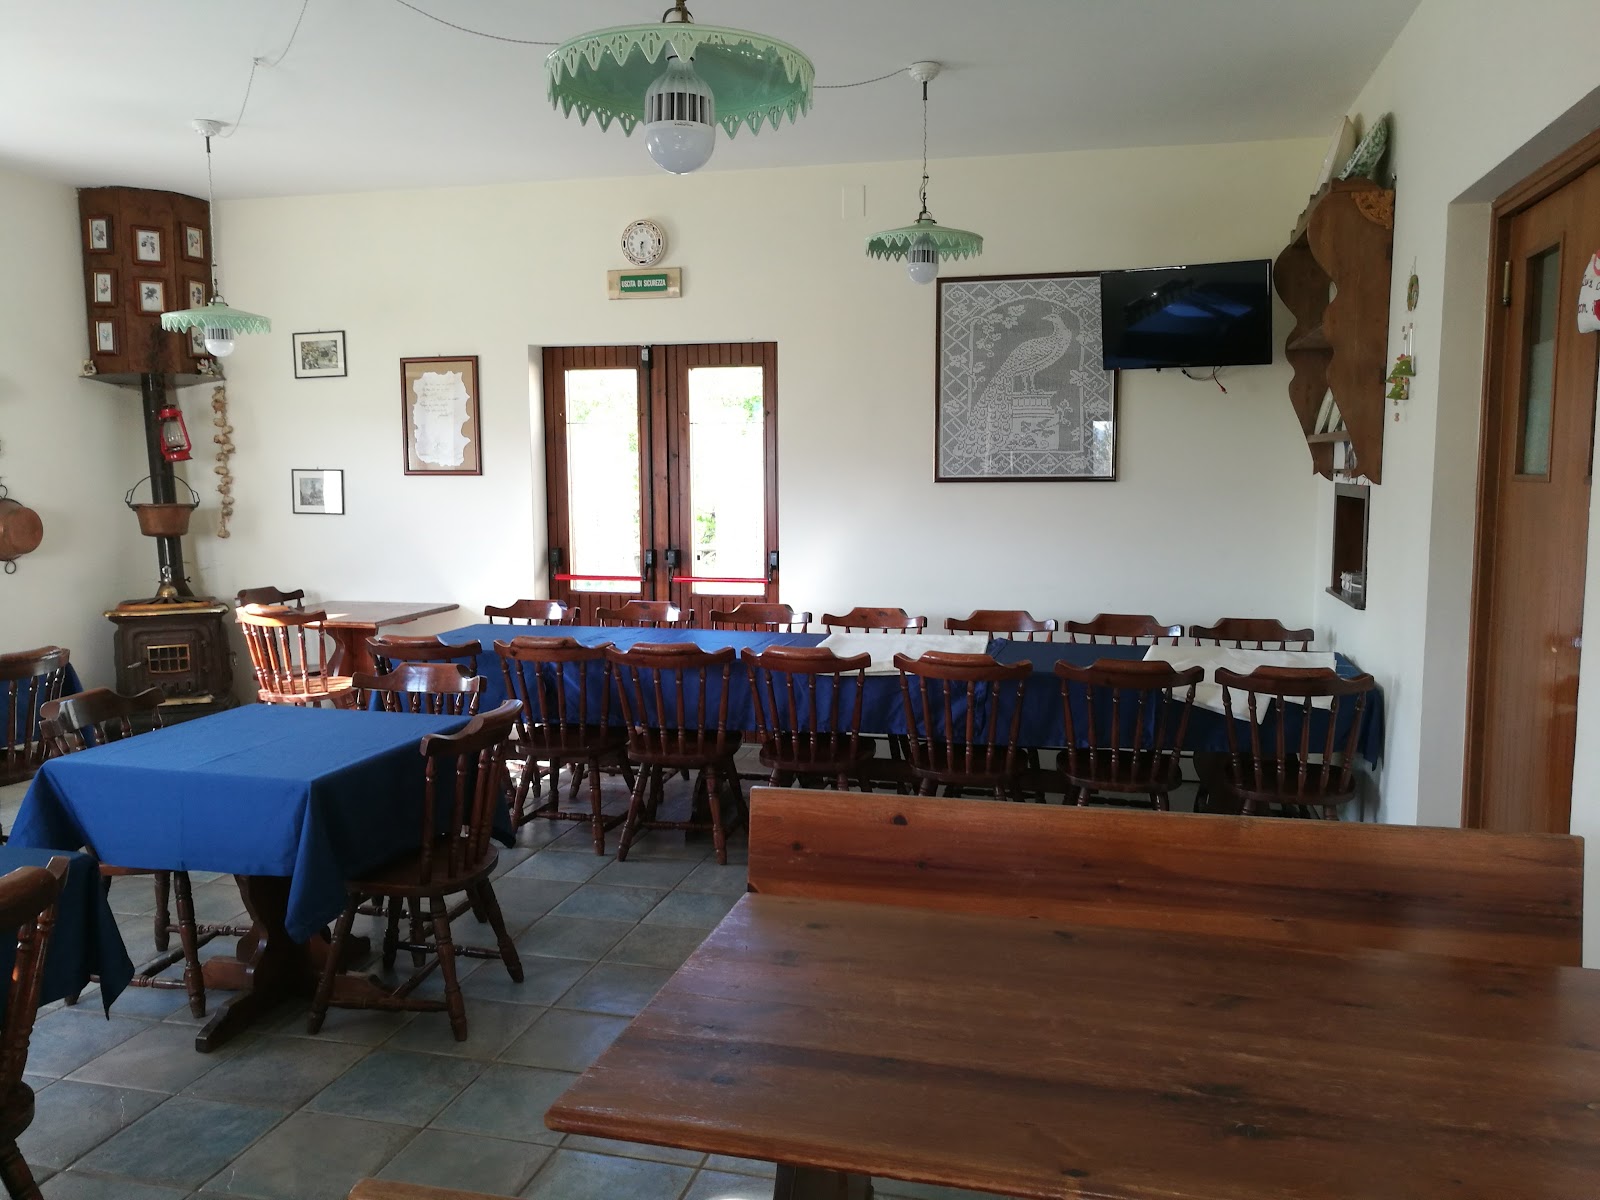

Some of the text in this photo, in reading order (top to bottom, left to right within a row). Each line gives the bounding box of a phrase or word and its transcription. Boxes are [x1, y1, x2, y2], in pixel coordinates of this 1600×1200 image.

[621, 279, 666, 288] USCITA DI SICUREZZA
